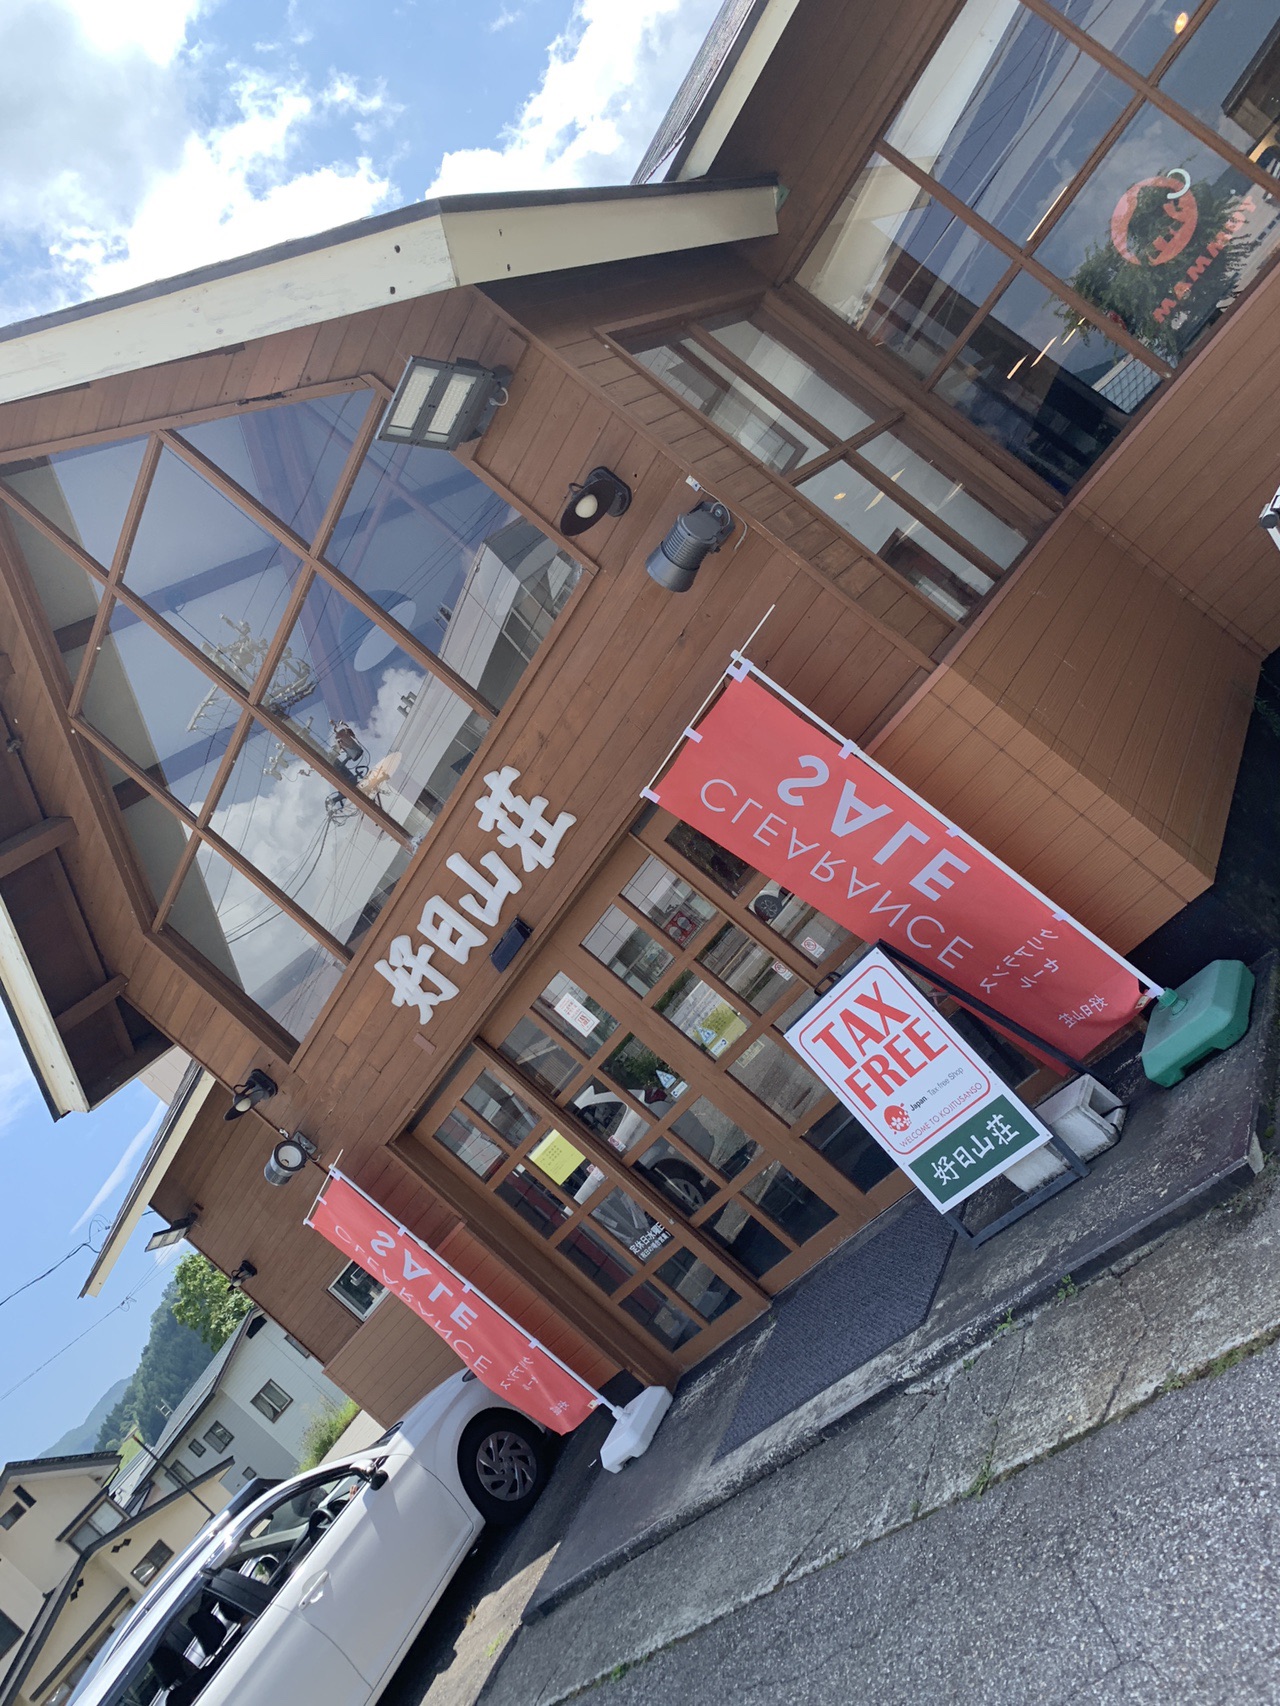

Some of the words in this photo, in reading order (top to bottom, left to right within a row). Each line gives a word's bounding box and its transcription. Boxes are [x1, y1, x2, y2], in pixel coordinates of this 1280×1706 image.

[1153, 195, 1257, 323] MAMMUT
[374, 765, 577, 1025] 好日山荘
[811, 981, 911, 1070] TAX
[844, 1017, 948, 1111] FREE
[899, 1123, 931, 1148] WELCOME
[929, 1115, 940, 1126] TO
[940, 1082, 983, 1118] KOJITUSANSO
[927, 1078, 950, 1097] Tax-free
[947, 1066, 964, 1081] Shop
[931, 1113, 1020, 1186] 好日山荘
